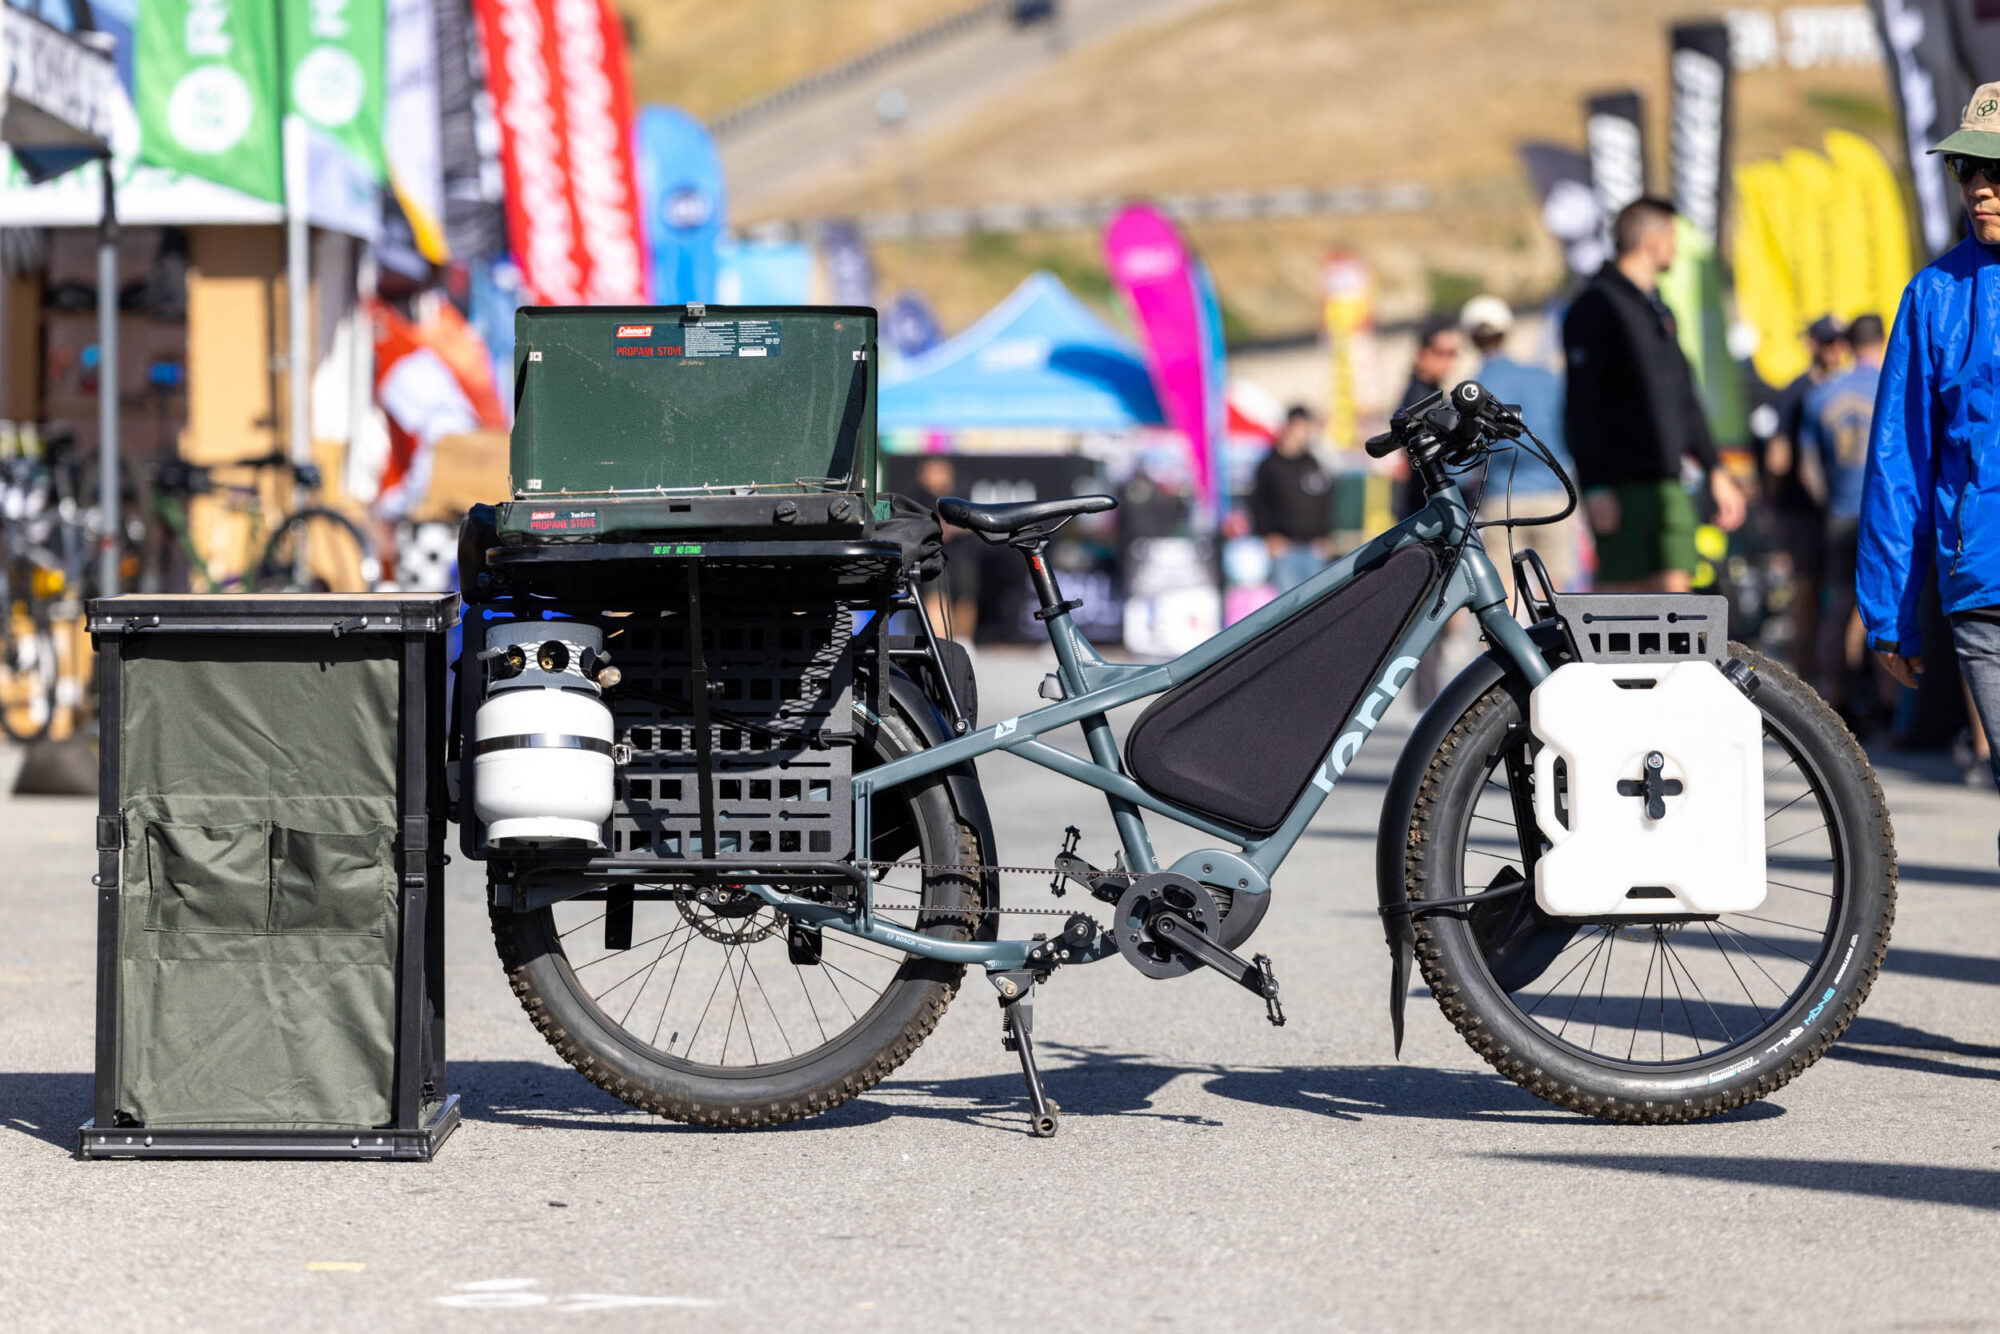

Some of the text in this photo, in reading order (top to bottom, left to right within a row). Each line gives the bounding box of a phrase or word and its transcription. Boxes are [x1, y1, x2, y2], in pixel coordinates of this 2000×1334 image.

[619, 326, 646, 336] Coleman
[616, 345, 683, 357] PROPANE STOVE
[530, 518, 597, 531] PROPANE STOVE
[653, 545, 702, 555] NO SIT NO STAND
[895, 935, 916, 947] BOSCH
[1802, 987, 1837, 1025] SNOW
